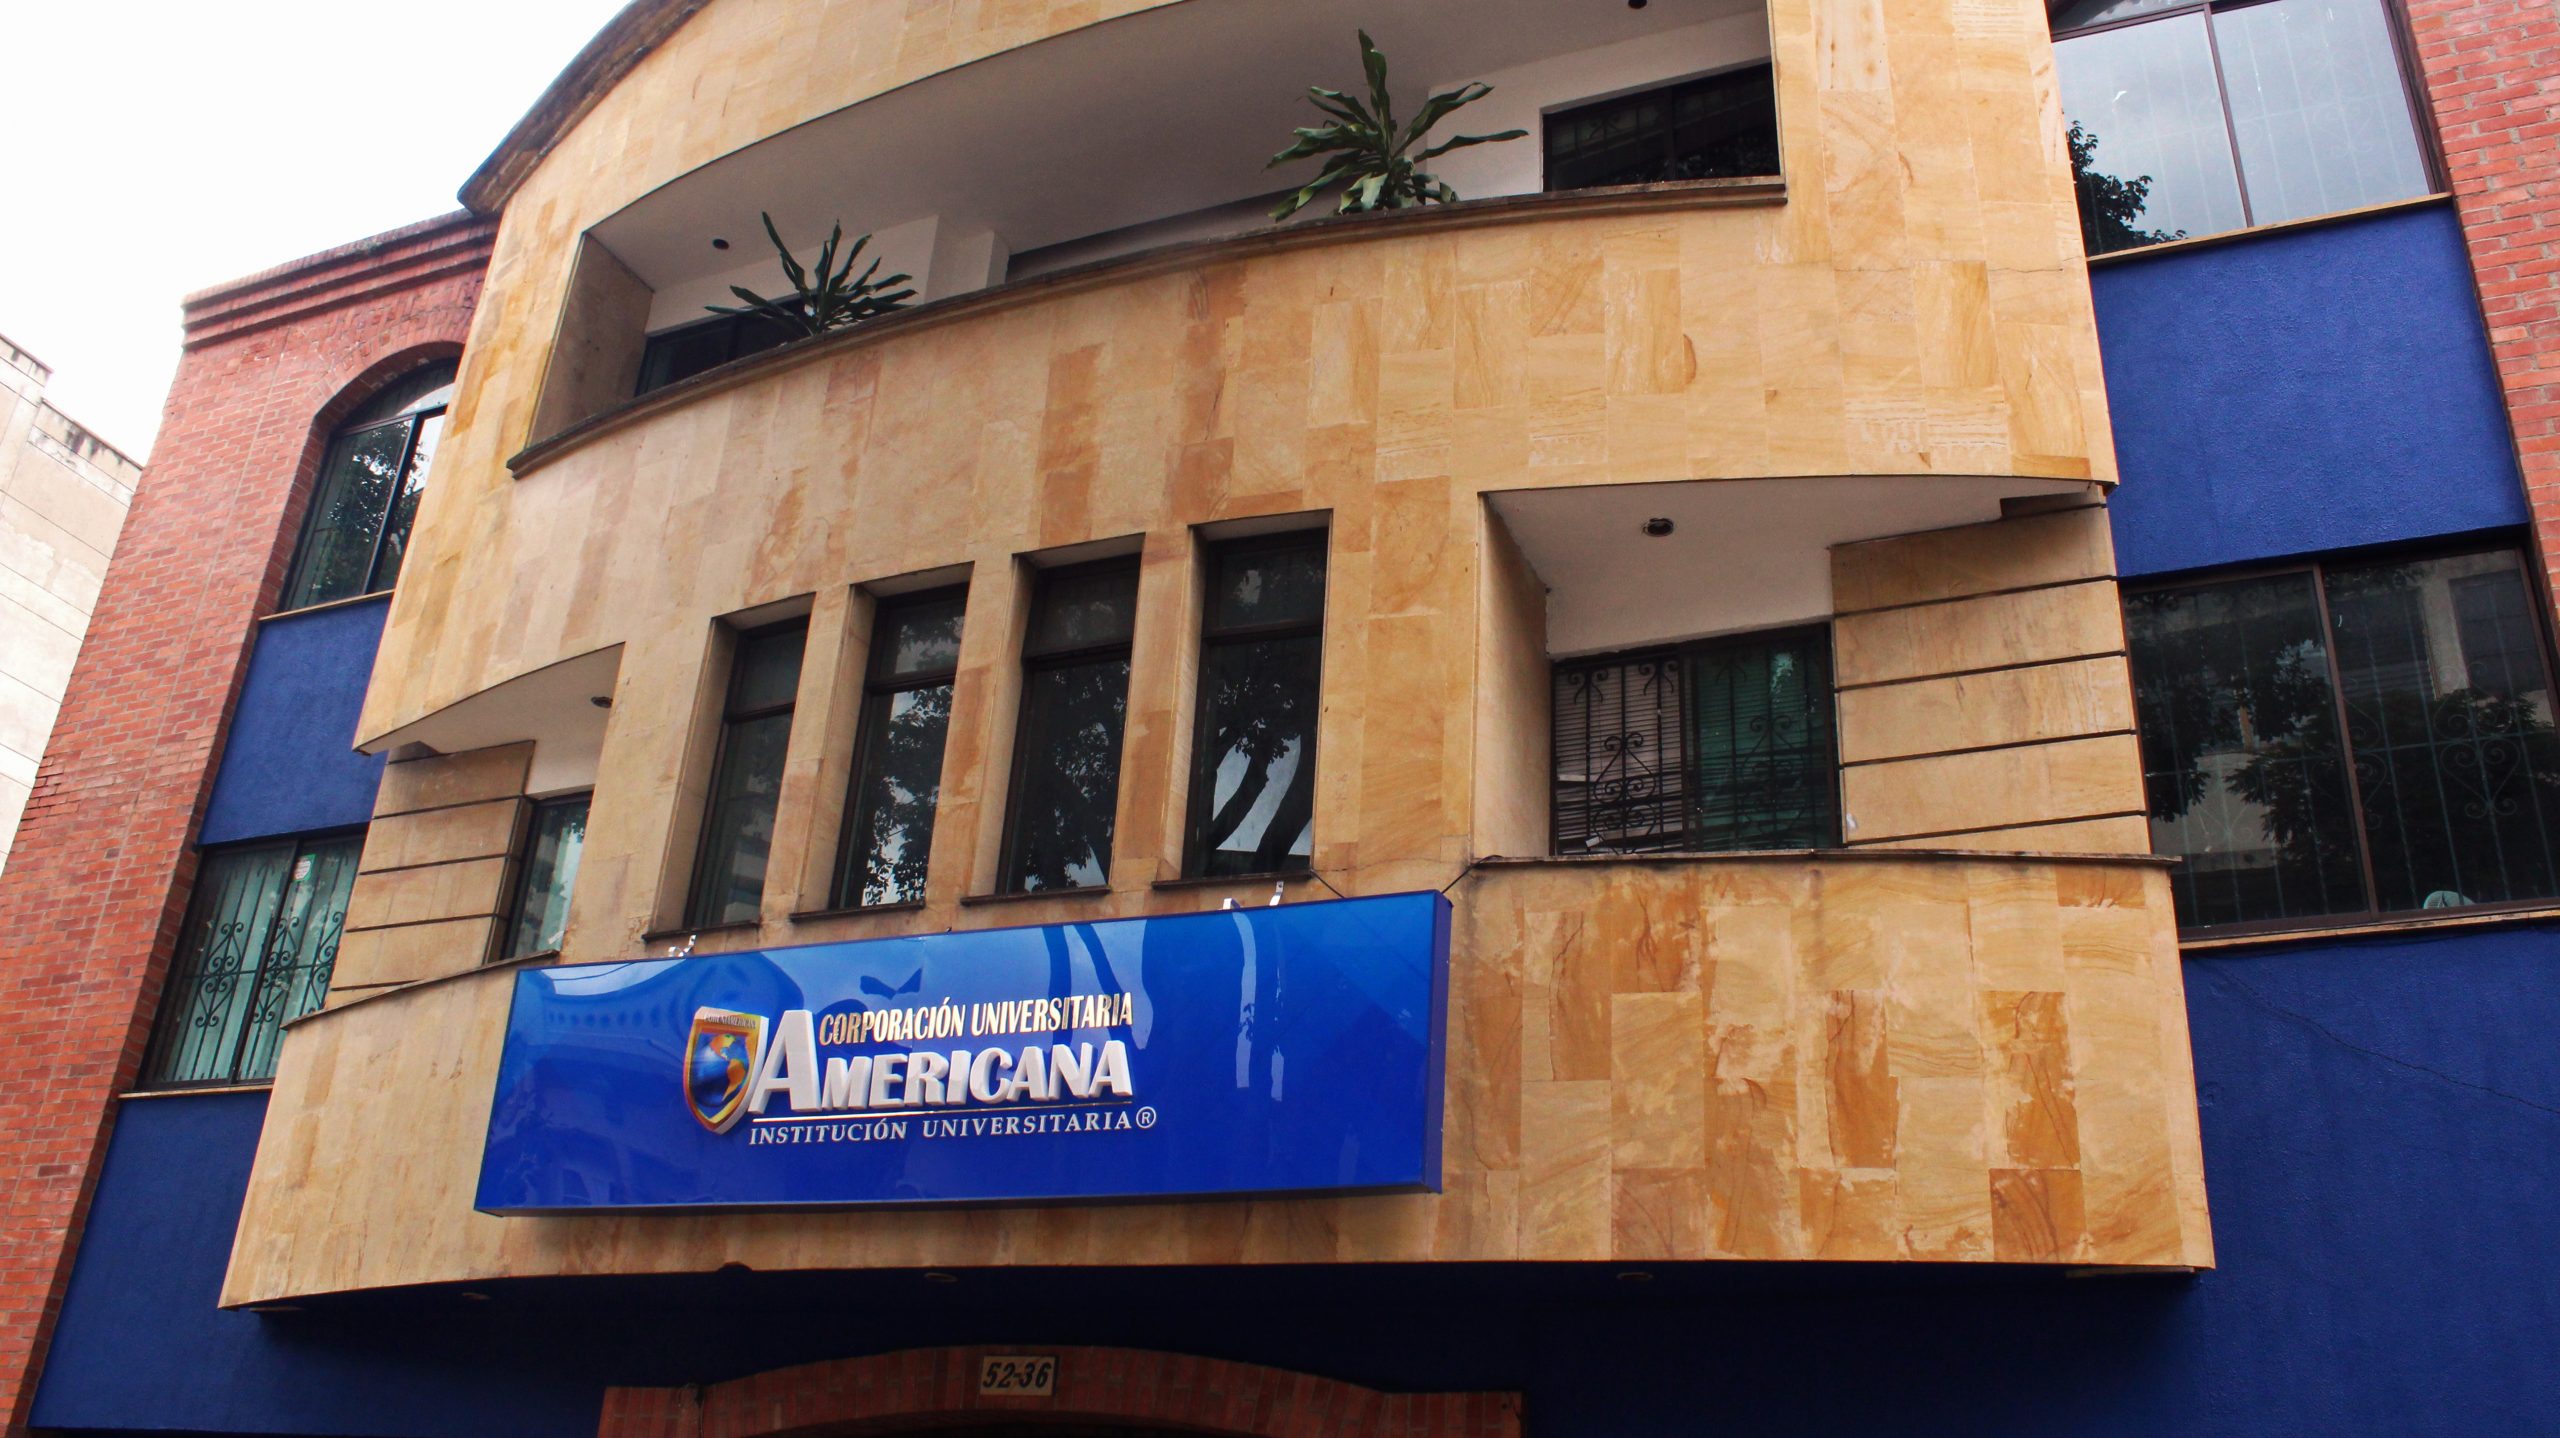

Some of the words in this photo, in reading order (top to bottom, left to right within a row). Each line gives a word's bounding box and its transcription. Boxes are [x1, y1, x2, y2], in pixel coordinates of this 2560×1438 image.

[818, 996, 966, 1046] CORPORACIÓN
[971, 992, 1133, 1037] UNIVERSITARIA
[747, 1009, 1133, 1114] AMERICANA
[749, 1118, 908, 1145] INSTITUCIÓN
[982, 1362, 1052, 1389] 52-36
